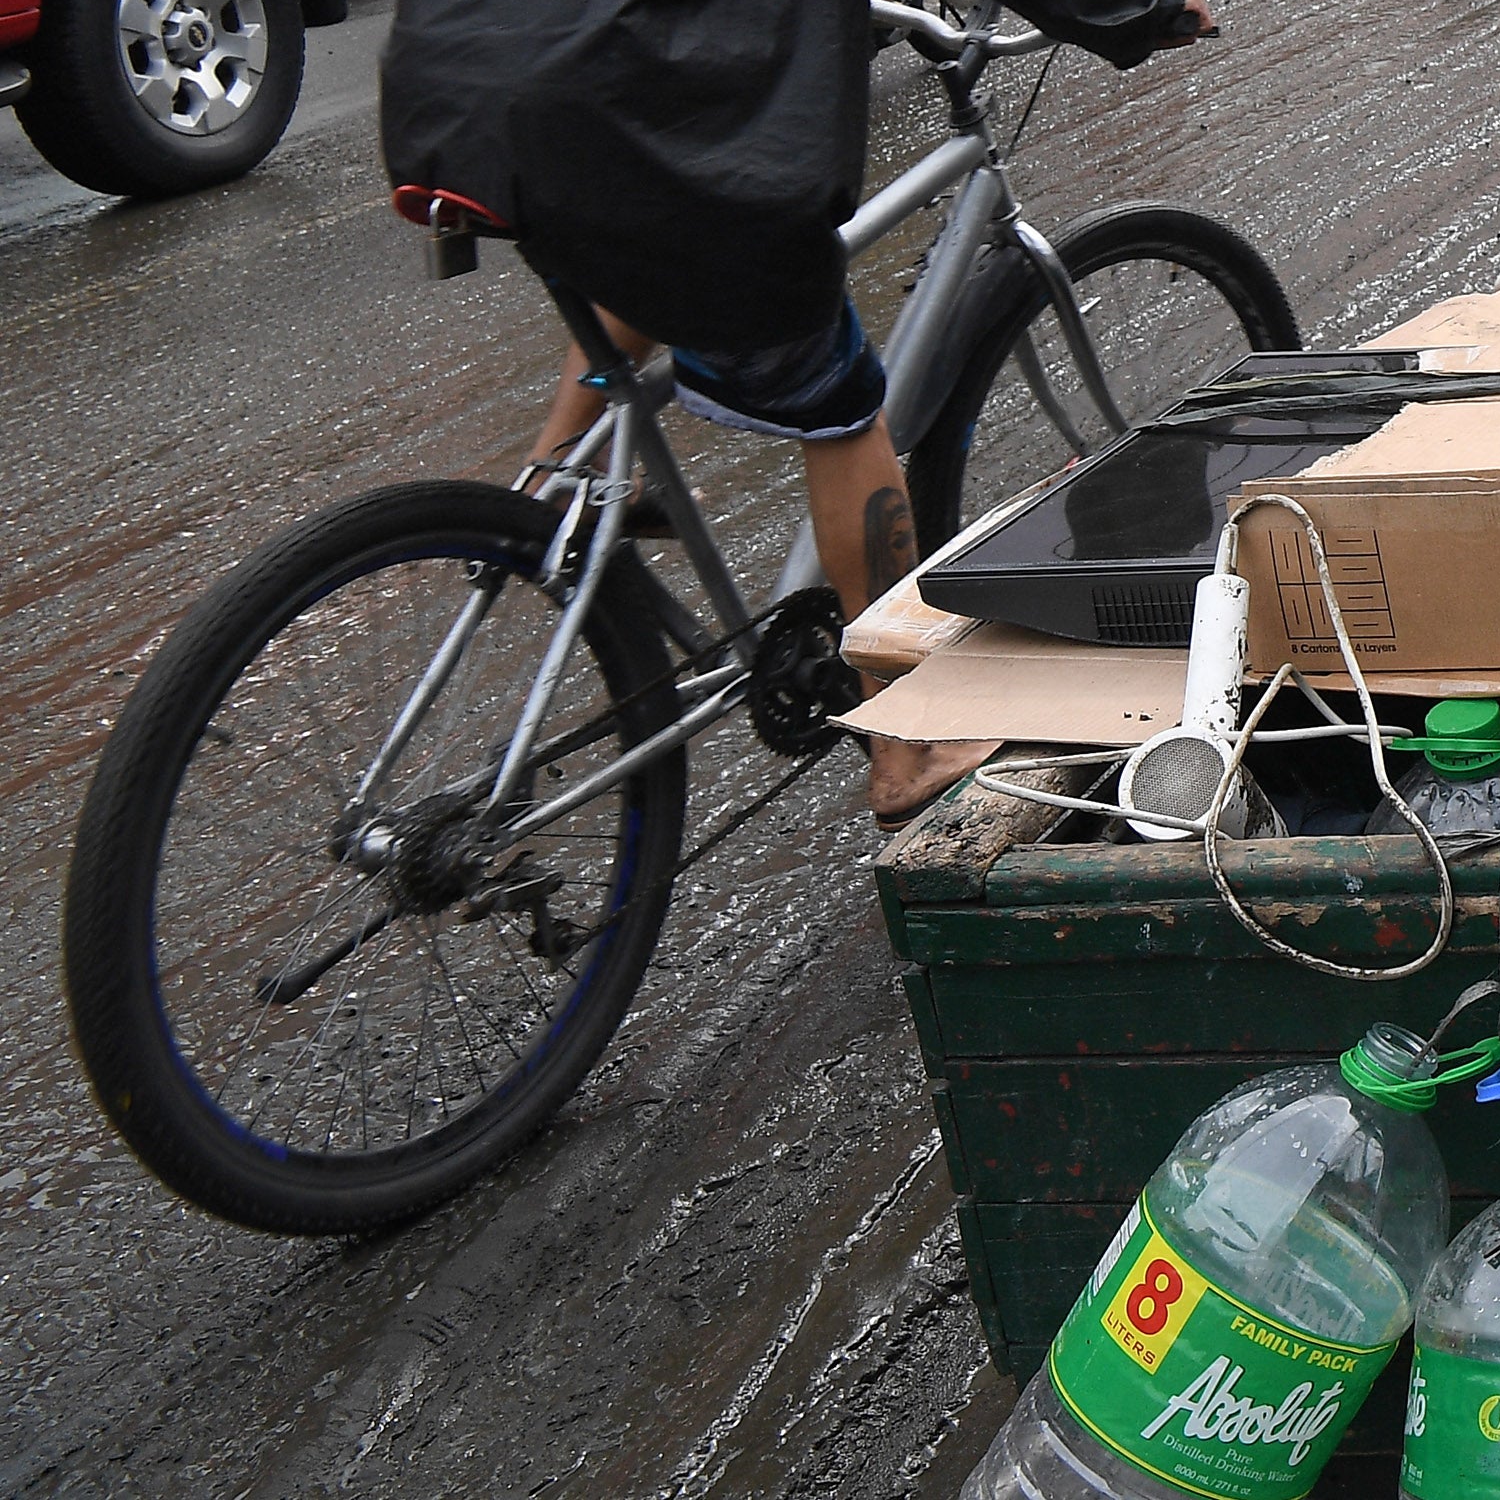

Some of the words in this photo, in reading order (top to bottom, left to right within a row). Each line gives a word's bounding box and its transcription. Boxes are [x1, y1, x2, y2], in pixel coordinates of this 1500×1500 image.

[1291, 644, 1298, 654] 8
[1355, 643, 1362, 652] 4
[1364, 643, 1397, 654] Layers
[1126, 1259, 1183, 1335] 8
[1105, 1310, 1156, 1366] LITERS
[1229, 1314, 1303, 1361] FAMILY
[1308, 1349, 1359, 1374] PACK
[1140, 1355, 1345, 1466] Absolute
[1162, 1433, 1213, 1467] Distilled
[1213, 1455, 1264, 1483] Drinking
[1267, 1467, 1298, 1484] Water
[1174, 1462, 1197, 1479] 8000
[1196, 1470, 1211, 1484] mL
[1216, 1477, 1231, 1491] 271
[1226, 1447, 1254, 1465] Pure
